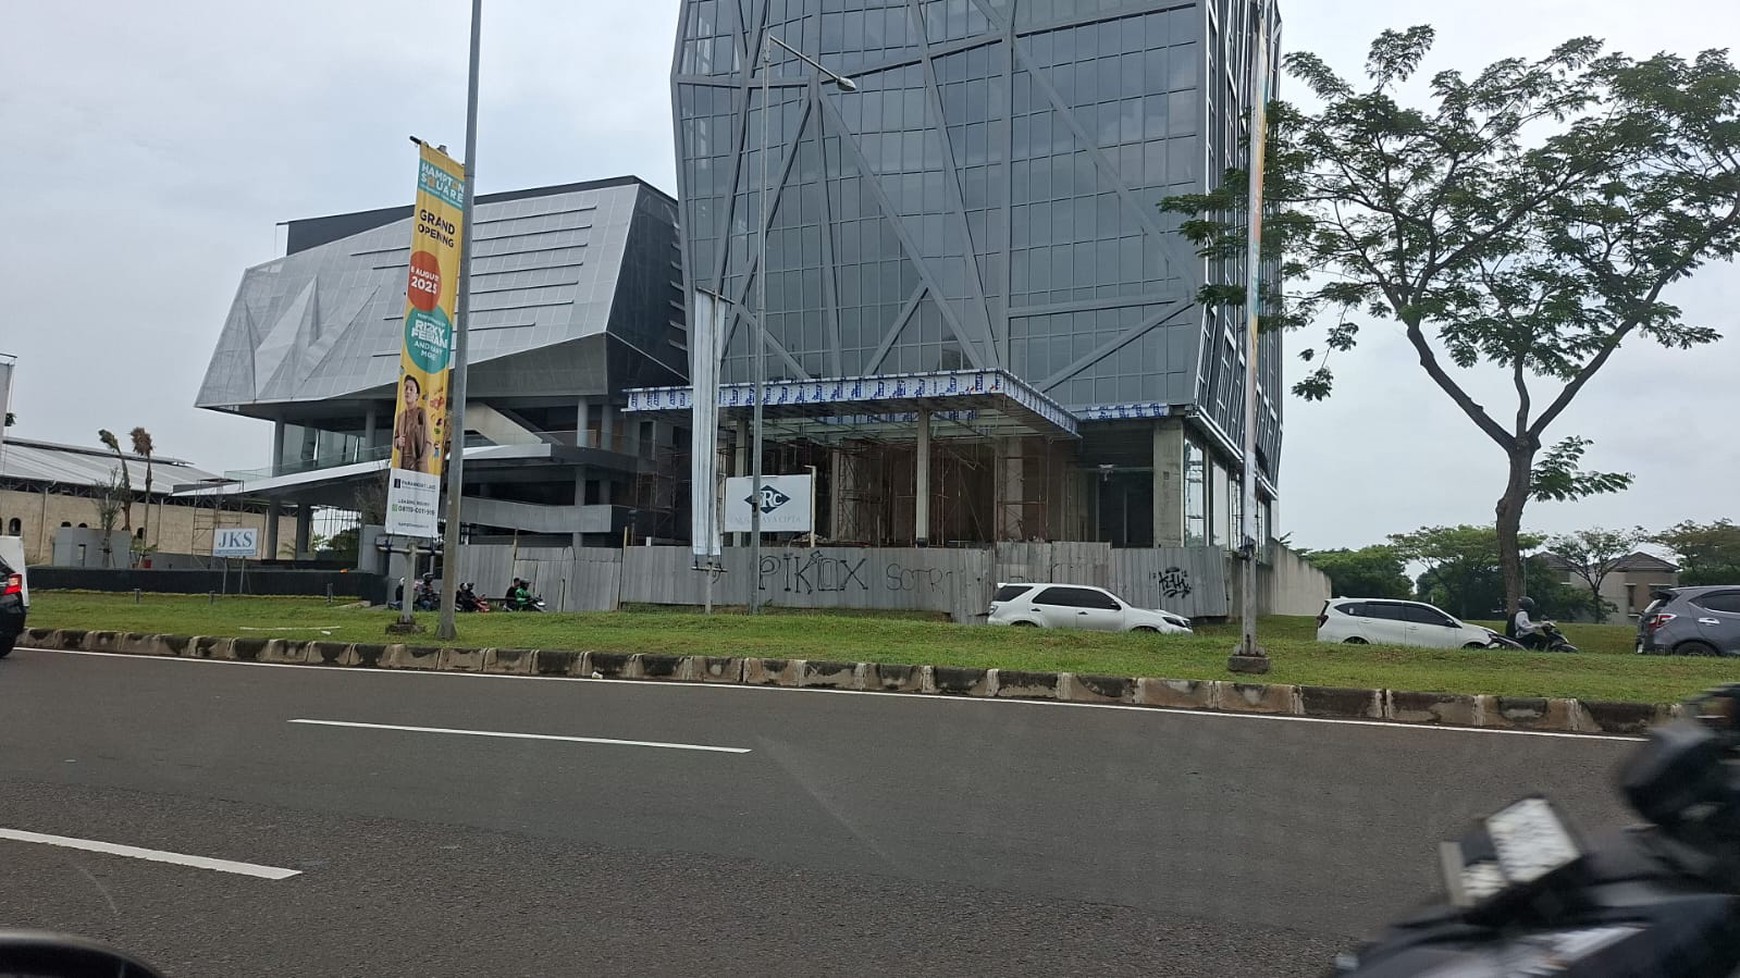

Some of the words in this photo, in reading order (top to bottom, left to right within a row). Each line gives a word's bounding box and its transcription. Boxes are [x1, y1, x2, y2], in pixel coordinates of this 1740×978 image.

[421, 162, 464, 193] HAMPTON
[421, 173, 464, 203] SQUARE
[420, 209, 456, 235] GRAND
[411, 276, 438, 295] 2025
[218, 531, 253, 548] JKS
